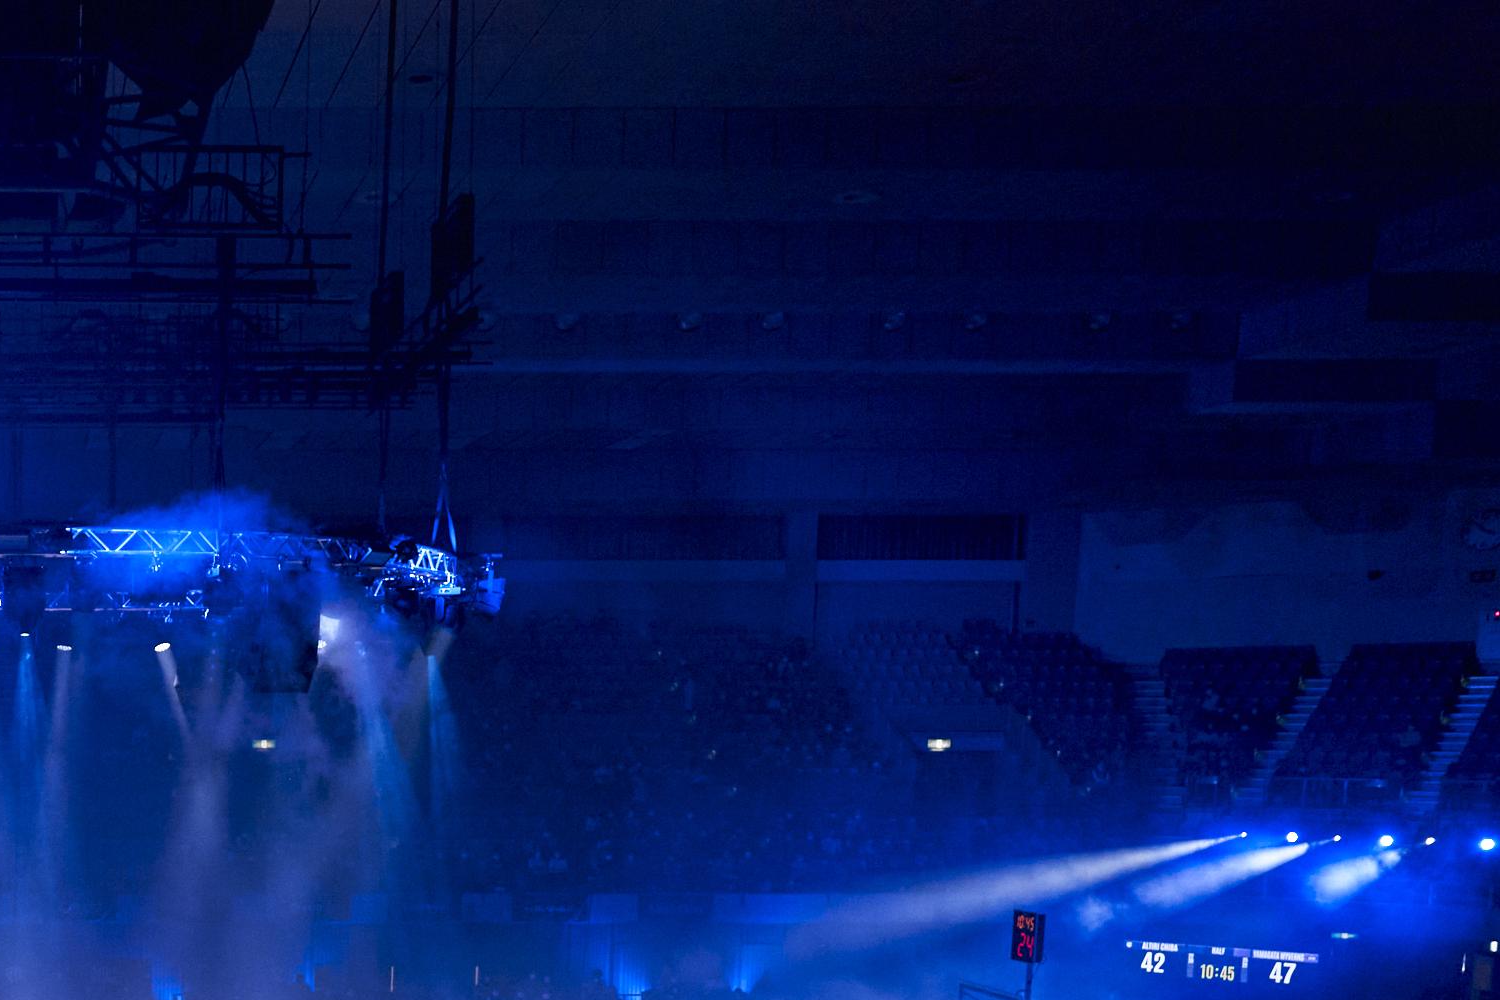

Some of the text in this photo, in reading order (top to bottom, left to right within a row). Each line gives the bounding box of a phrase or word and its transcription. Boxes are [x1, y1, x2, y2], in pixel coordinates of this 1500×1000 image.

[1017, 931, 1034, 957] 24
[1141, 951, 1165, 973] 42
[1200, 963, 1235, 981] 10:45
[1269, 962, 1297, 984] 47
